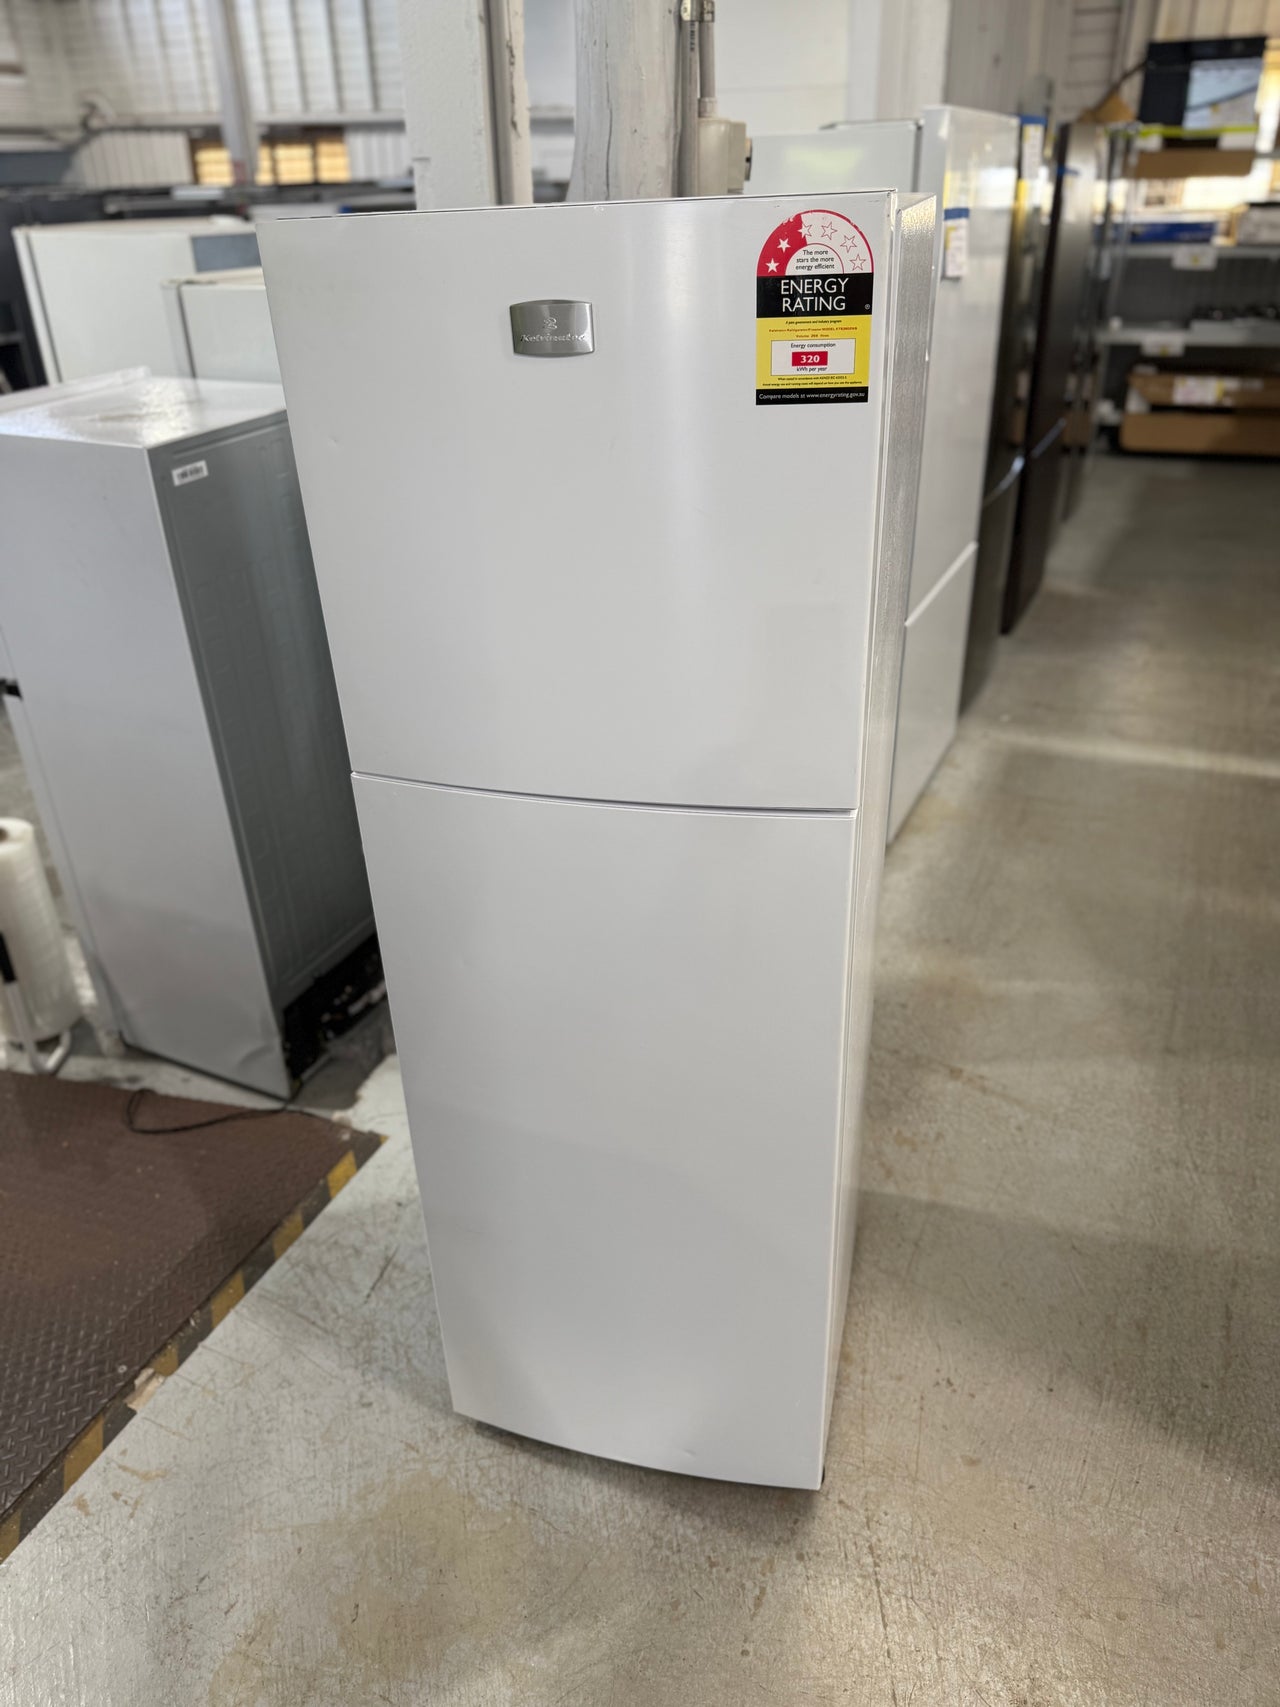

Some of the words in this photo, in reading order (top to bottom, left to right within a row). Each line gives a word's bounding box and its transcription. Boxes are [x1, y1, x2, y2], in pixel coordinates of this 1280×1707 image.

[780, 278, 849, 294] ENERGY
[782, 296, 846, 312] RATING
[800, 354, 820, 363] 320
